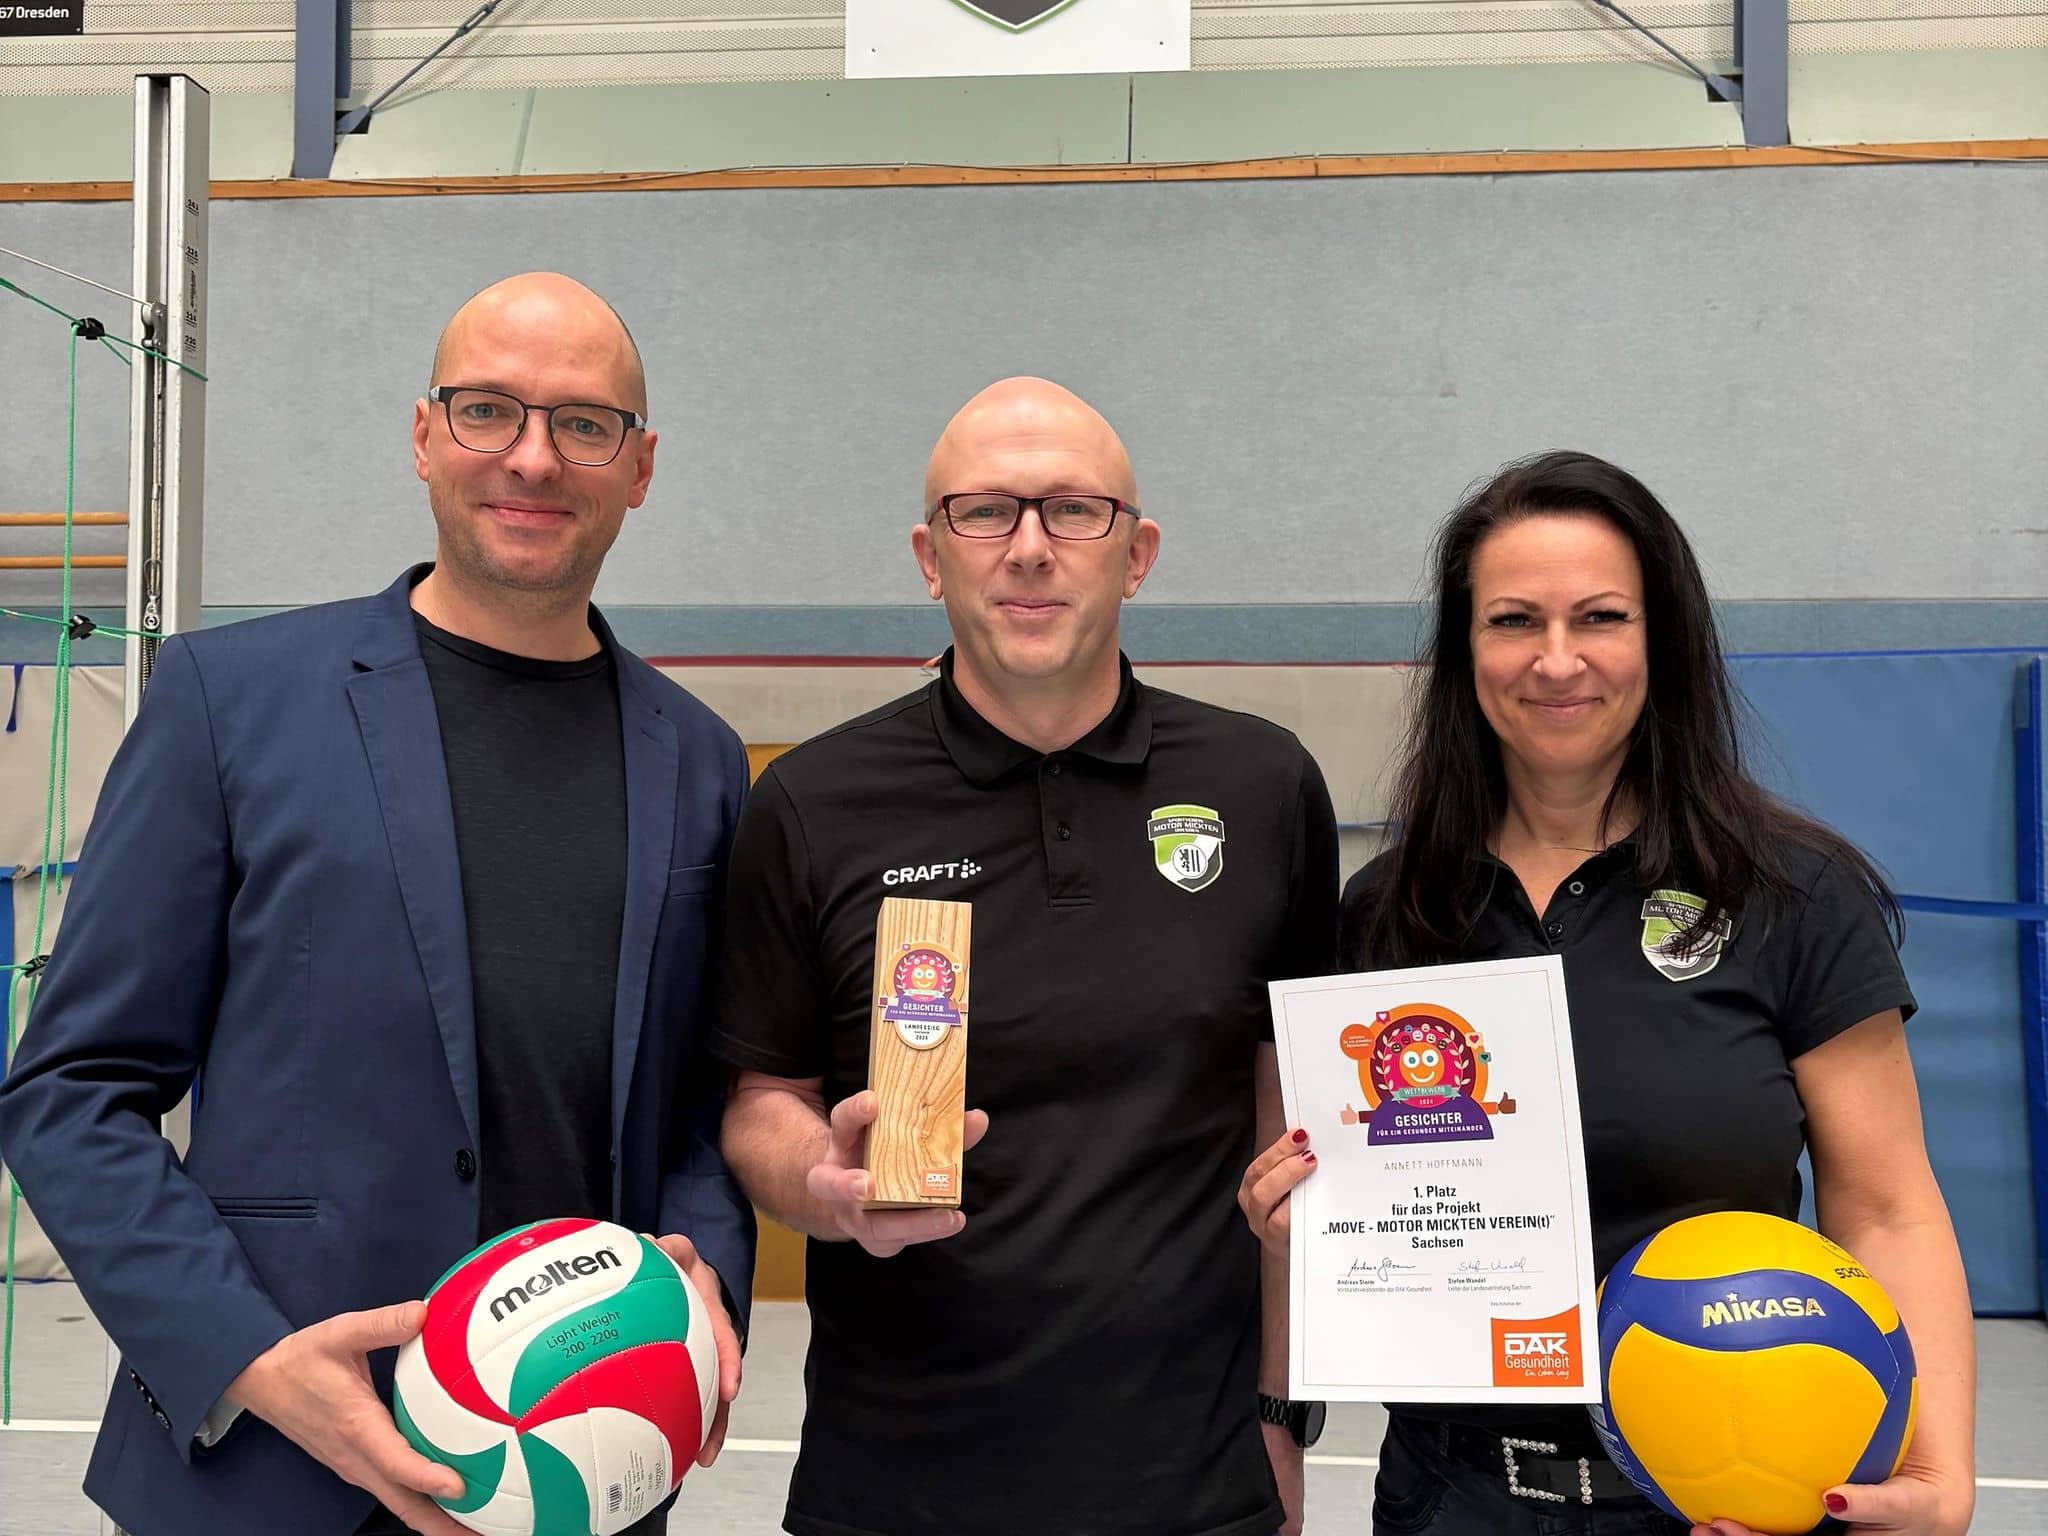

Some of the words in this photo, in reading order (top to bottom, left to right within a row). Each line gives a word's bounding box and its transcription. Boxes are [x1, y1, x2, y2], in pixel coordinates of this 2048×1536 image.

[16, 6, 69, 18] Dresden
[1153, 821, 1182, 832] MOTOR
[1184, 822, 1219, 833] MICKTEN
[883, 863, 960, 885] CRAFT
[903, 1002, 944, 1012] GESICHTER
[1395, 1112, 1463, 1127] GESICHTER
[1403, 1127, 1437, 1135] GESUNDES
[1438, 1124, 1484, 1133] MITEINANDER
[1384, 1160, 1423, 1171] ANNETT
[1426, 1157, 1483, 1169] HOFFMANN
[1413, 1186, 1424, 1199] 1.
[1426, 1185, 1457, 1198] Platz
[1391, 1203, 1409, 1216] für
[1411, 1203, 1433, 1215] das
[1436, 1201, 1481, 1216] Projekt
[1377, 1220, 1423, 1233] MOTOR
[1426, 1217, 1486, 1231] MICKTEN
[1411, 1236, 1464, 1249] Sachsen
[490, 1249, 622, 1322] molten
[1702, 1291, 1826, 1328] MIKASA
[546, 1327, 578, 1349] Light
[578, 1311, 621, 1333] Weight
[1504, 1332, 1568, 1355] DAK
[1505, 1354, 1569, 1369] Gesundheit
